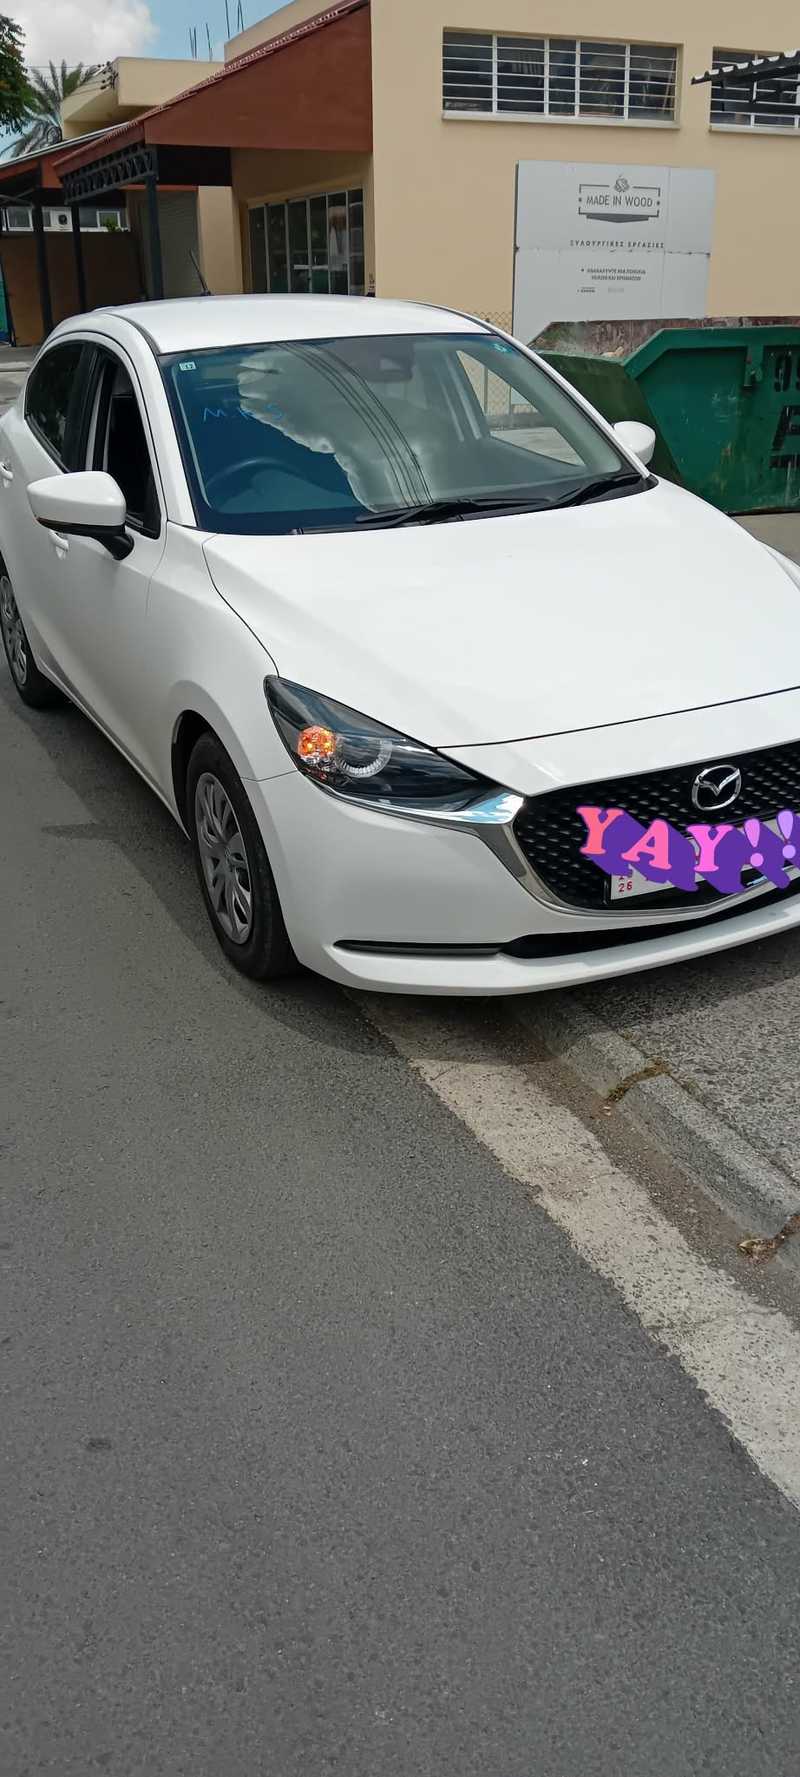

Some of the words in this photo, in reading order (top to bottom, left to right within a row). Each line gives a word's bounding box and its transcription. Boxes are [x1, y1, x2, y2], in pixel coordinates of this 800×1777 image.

[586, 195, 610, 206] MADE
[613, 195, 621, 206] IN
[625, 196, 653, 207] WOOD
[618, 881, 633, 892] 26
